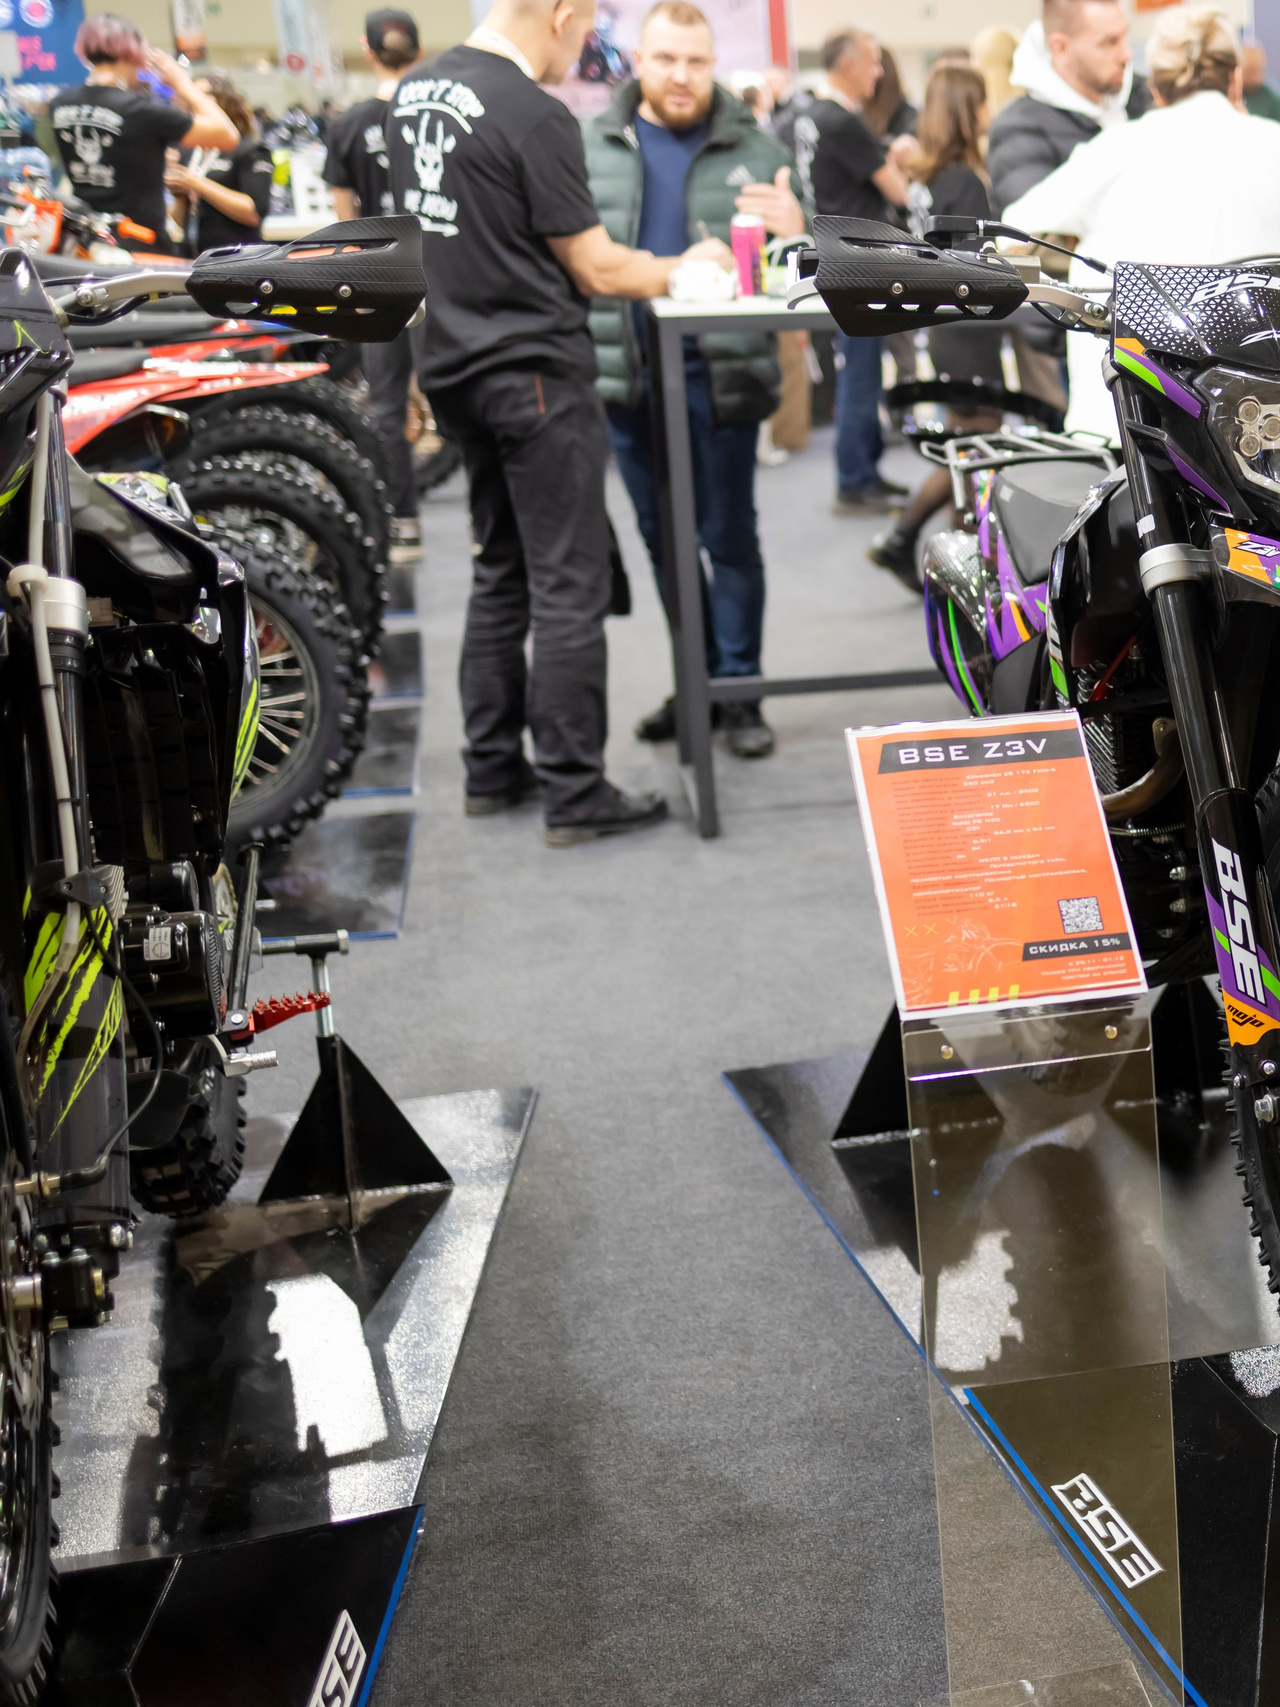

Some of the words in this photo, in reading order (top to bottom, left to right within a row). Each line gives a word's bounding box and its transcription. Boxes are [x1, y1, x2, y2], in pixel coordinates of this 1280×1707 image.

[898, 744, 970, 765] BSE
[984, 738, 1048, 760] Z3V
[1029, 940, 1088, 955] СКИДКА
[1093, 937, 1121, 948] 15%
[1211, 837, 1266, 1005] BSE
[1050, 1472, 1165, 1590] BSE
[306, 1609, 367, 1707] SE
